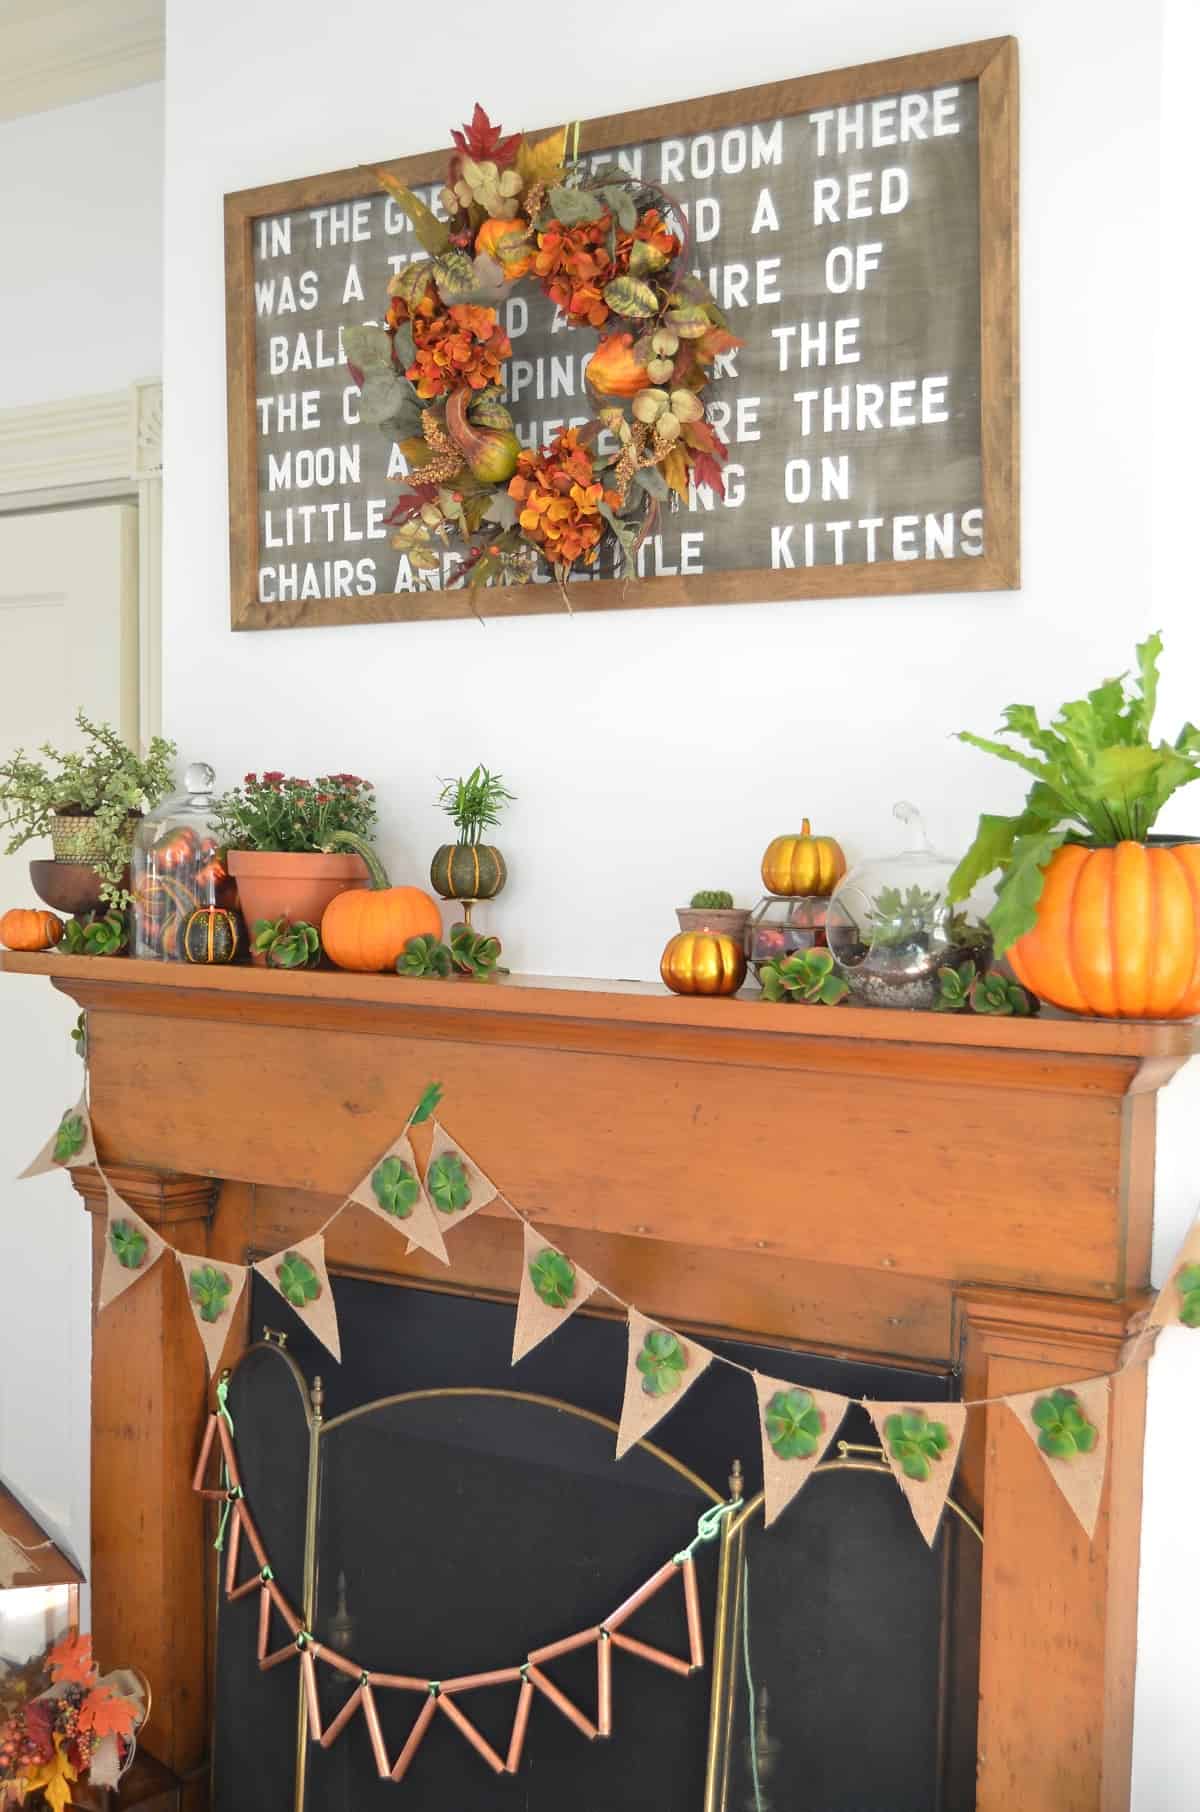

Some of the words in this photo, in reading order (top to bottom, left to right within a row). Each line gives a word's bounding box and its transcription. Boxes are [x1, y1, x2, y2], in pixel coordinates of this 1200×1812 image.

[261, 218, 291, 259] IN
[310, 202, 371, 248] THE
[661, 121, 782, 184] ROOM
[809, 88, 960, 156] THERE
[255, 271, 318, 316] WAS
[343, 264, 364, 304] A
[751, 188, 780, 233] A
[814, 168, 909, 225] RED
[825, 243, 882, 294] OF
[256, 391, 320, 435] THE
[771, 318, 861, 371] THE
[269, 444, 360, 492] MOON
[794, 376, 949, 437] THREE
[258, 558, 377, 603] CHAIRS
[770, 508, 983, 569] KITTENS
[265, 500, 387, 548] LITTLE
[784, 455, 849, 504] ON
